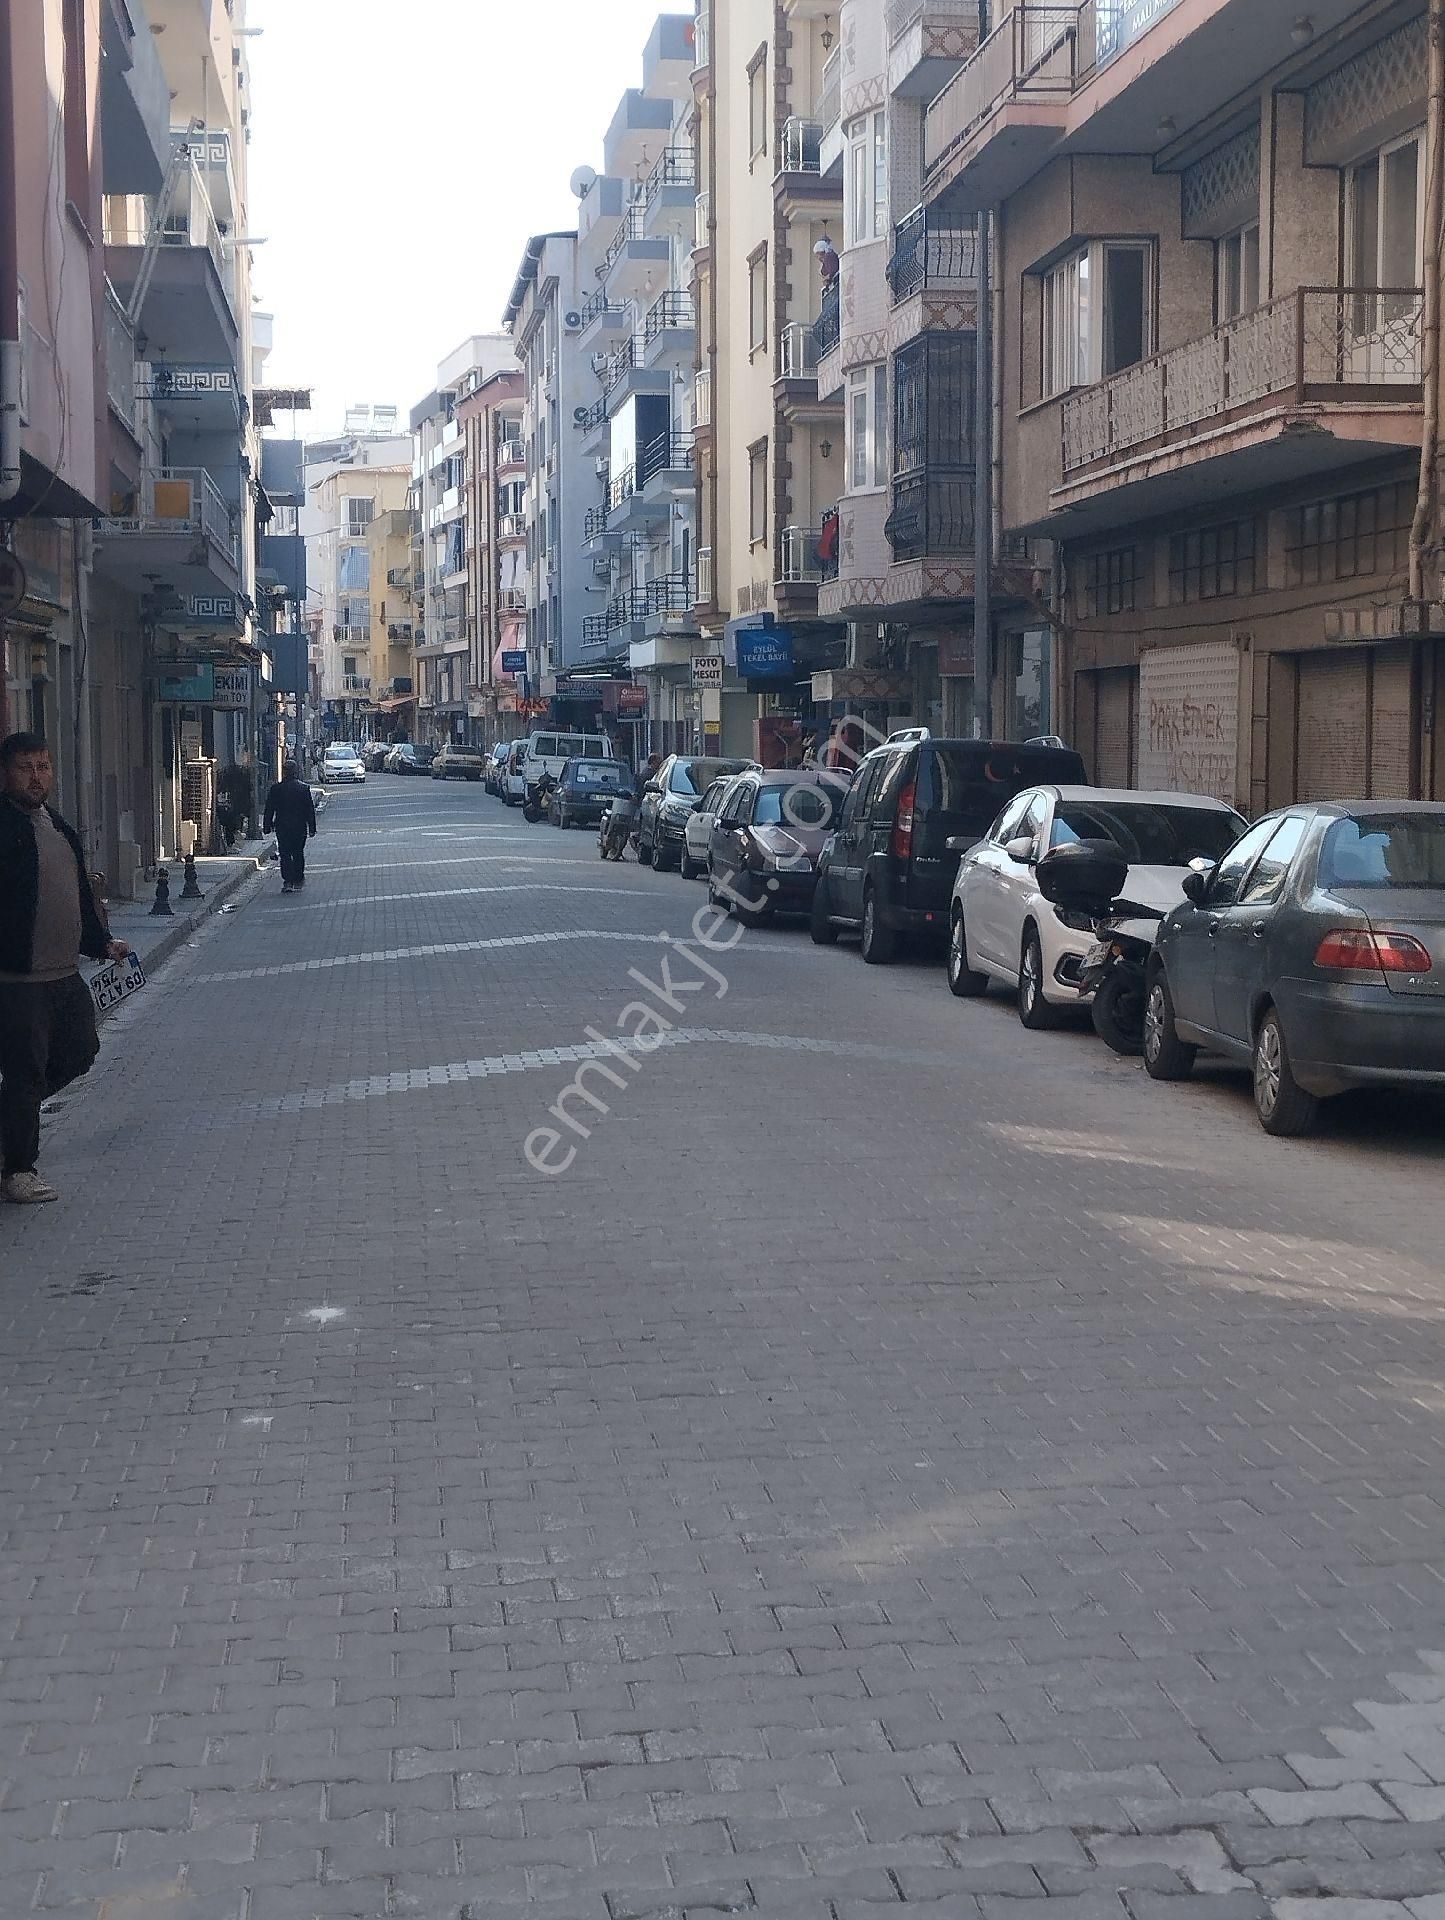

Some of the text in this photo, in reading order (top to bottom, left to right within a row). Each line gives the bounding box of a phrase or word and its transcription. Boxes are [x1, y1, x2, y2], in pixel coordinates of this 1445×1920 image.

[695, 658, 718, 668] FOTO
[743, 654, 766, 662] TEKEL
[693, 669, 721, 679] MESUT
